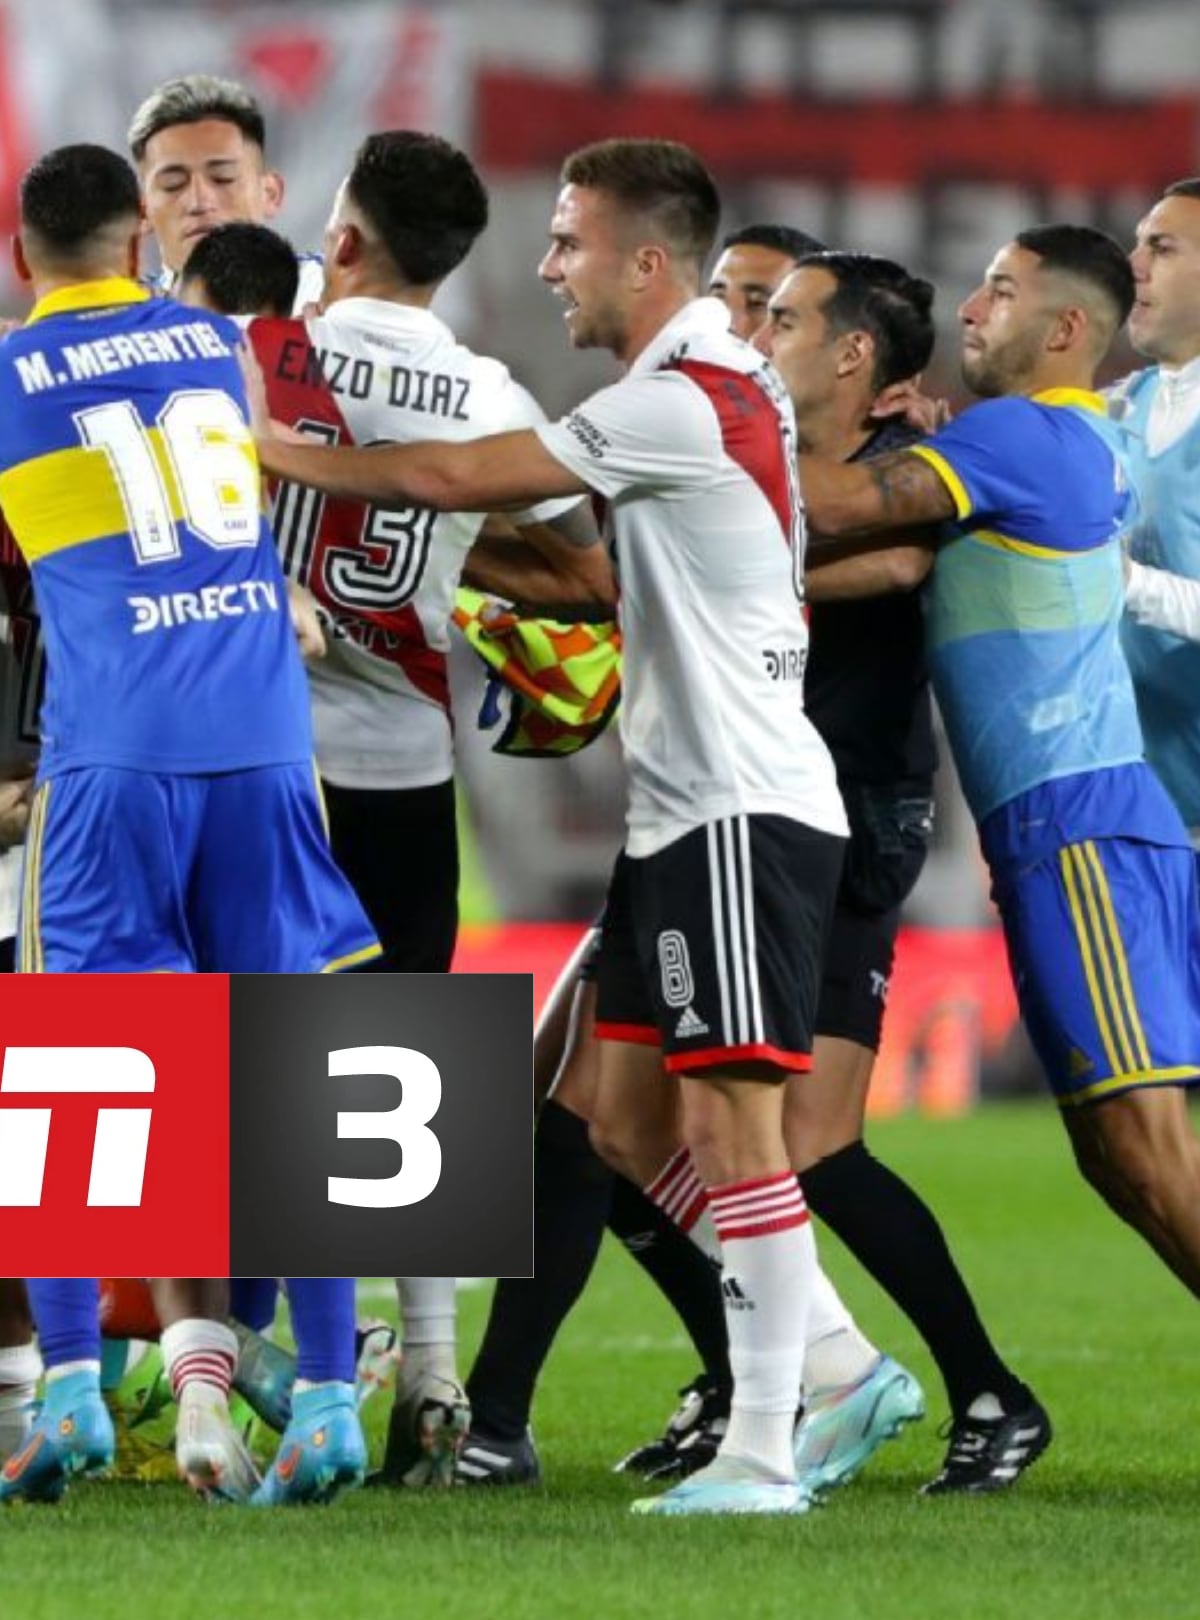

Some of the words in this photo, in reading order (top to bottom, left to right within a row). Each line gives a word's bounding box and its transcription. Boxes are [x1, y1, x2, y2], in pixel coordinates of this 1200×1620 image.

[275, 338, 374, 399] ENZO
[390, 366, 471, 421] DIAZ
[72, 388, 261, 566] 16
[127, 580, 279, 635] DIRECTV
[657, 929, 694, 1008] 8
